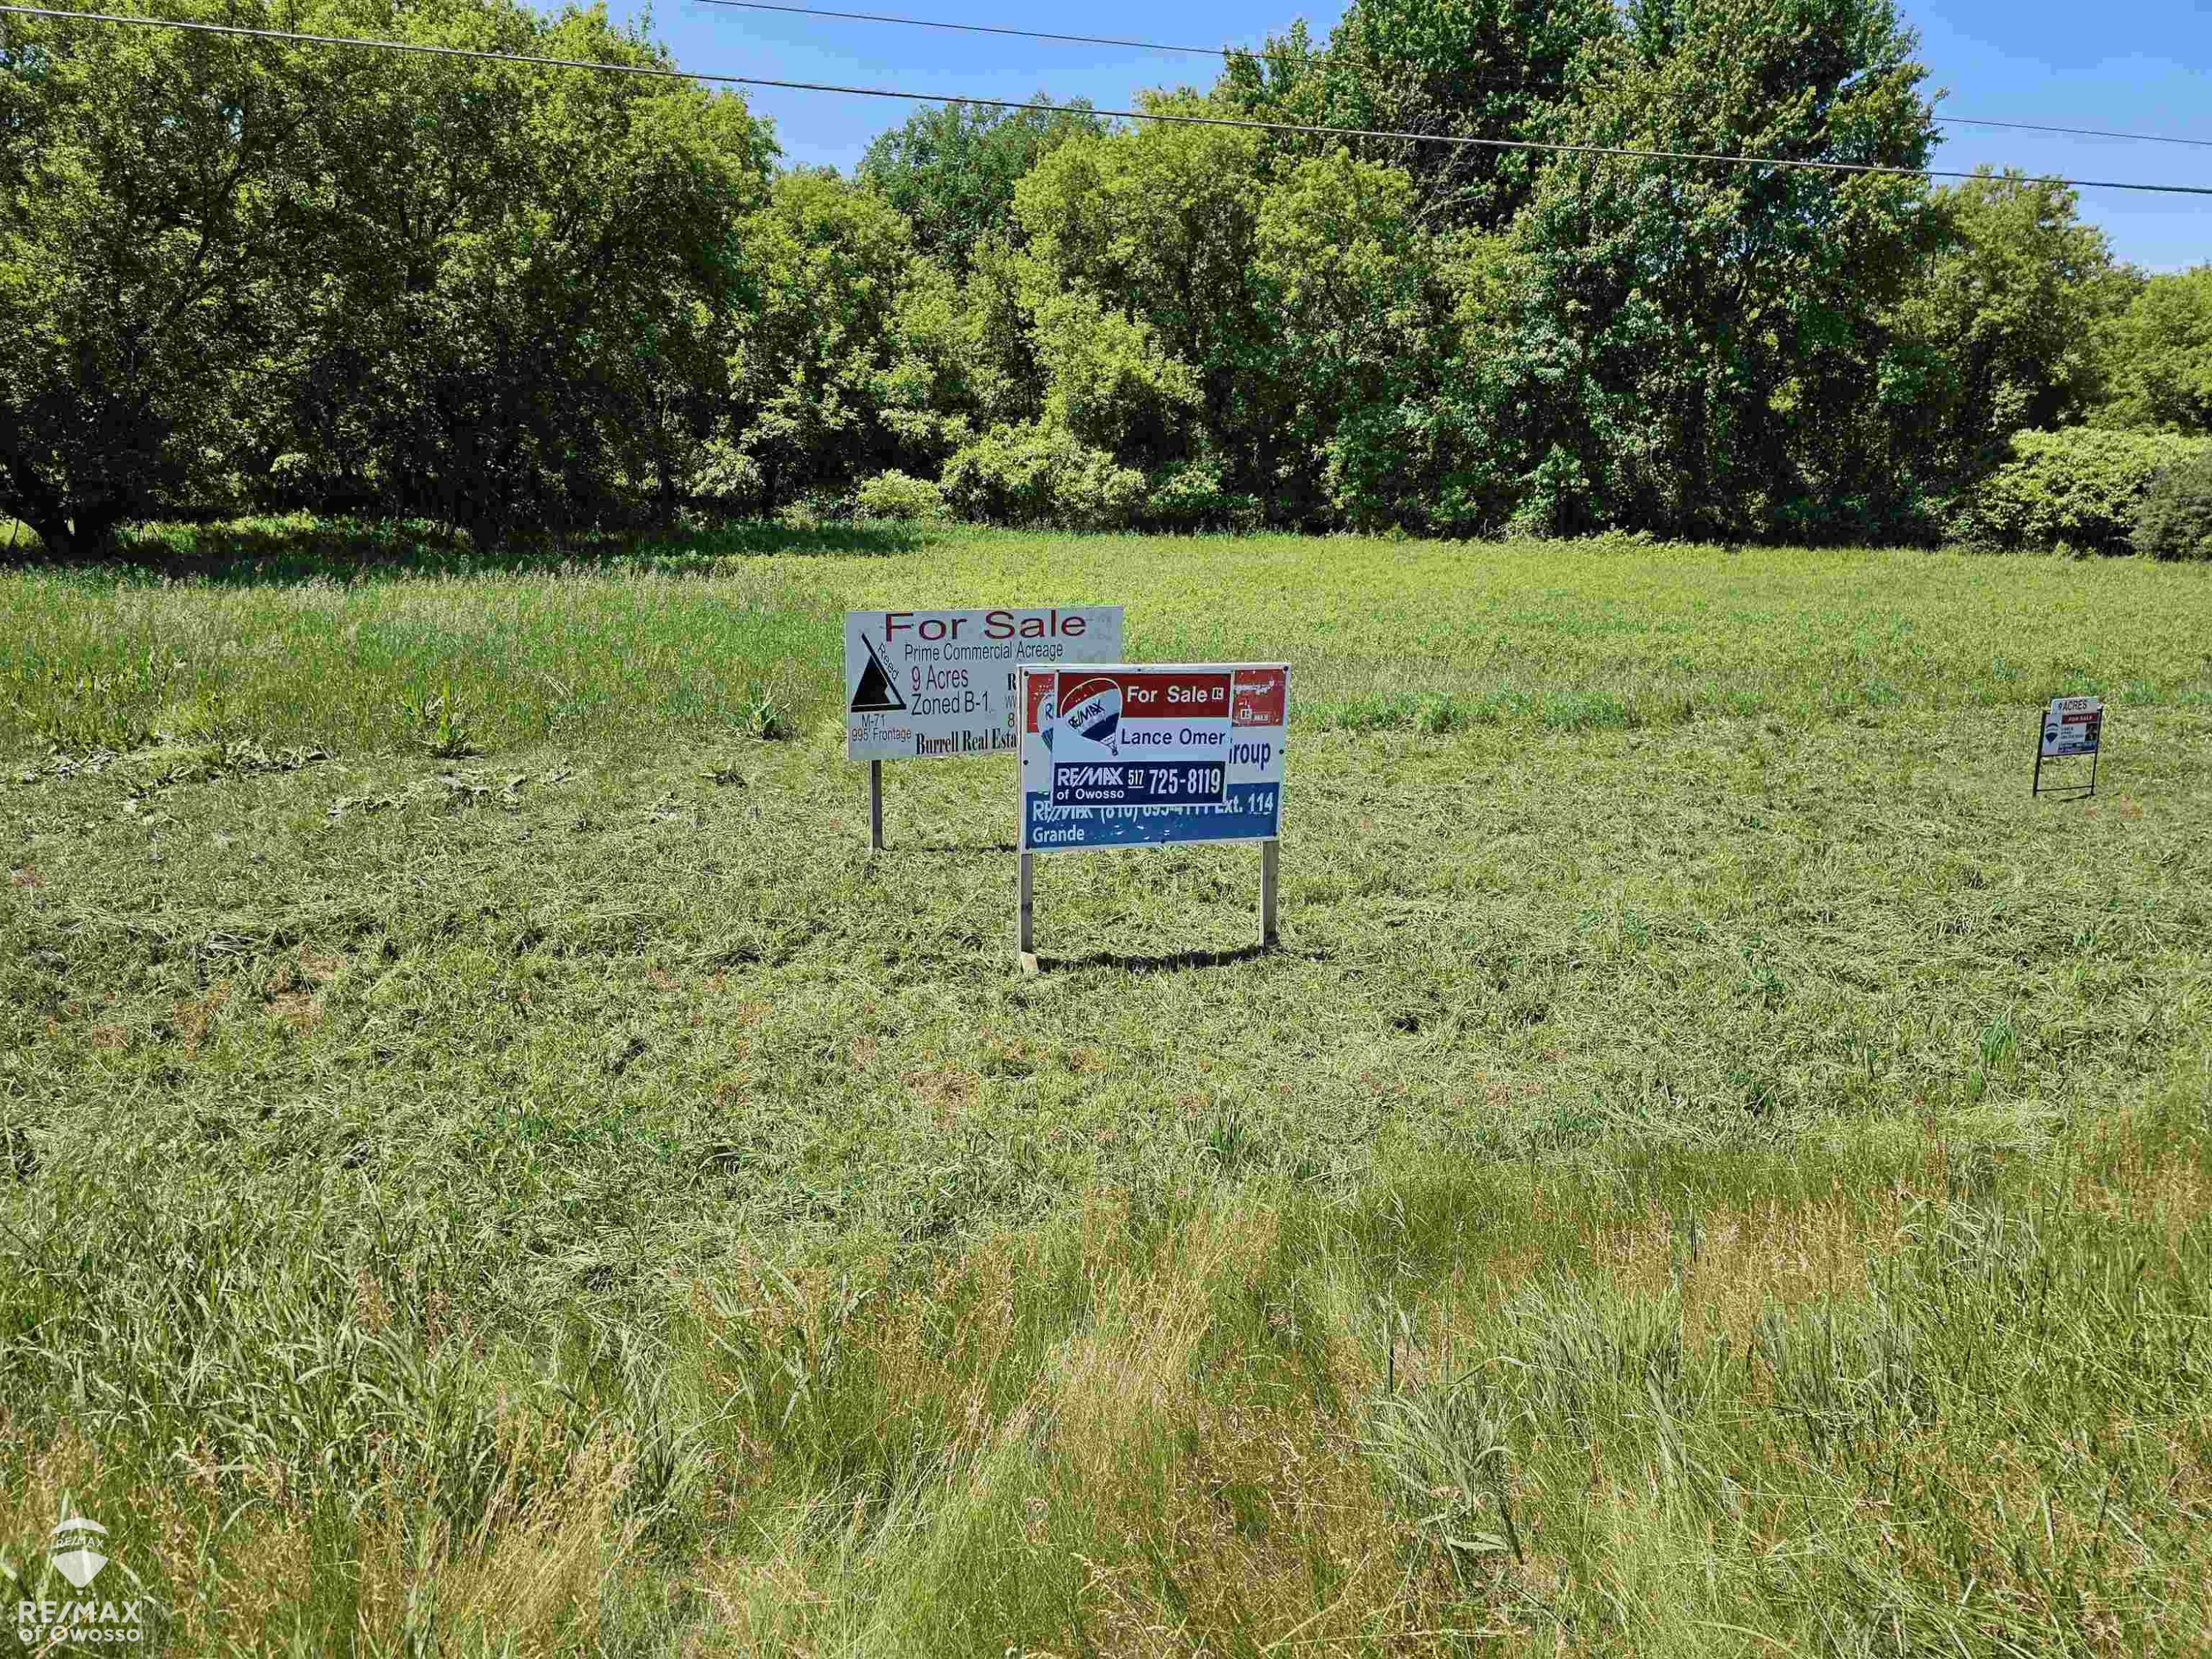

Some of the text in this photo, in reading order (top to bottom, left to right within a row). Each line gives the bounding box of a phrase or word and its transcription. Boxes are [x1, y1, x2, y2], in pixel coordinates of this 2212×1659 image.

[886, 609, 1086, 642] For Sale
[905, 640, 1063, 661] Prime Commercial Acreage
[911, 665, 968, 692] 9 Acres
[911, 691, 959, 715] Zoned
[964, 690, 989, 712] B-1
[1127, 685, 1158, 703] For
[1167, 685, 1208, 703] Sale
[861, 714, 886, 727] M-71
[1068, 699, 1105, 729] RE/MAX
[873, 726, 911, 743] Frontage
[916, 727, 1017, 755] Burrell Real Esta
[1121, 728, 1225, 745] Lance Omer
[1228, 742, 1271, 771] roup
[1057, 766, 1124, 787] RE/MAX
[1128, 768, 1220, 795] 517 725-8119
[1057, 787, 1124, 800] of Owosso
[1248, 792, 1273, 814] 114
[1033, 823, 1085, 843] Grande
